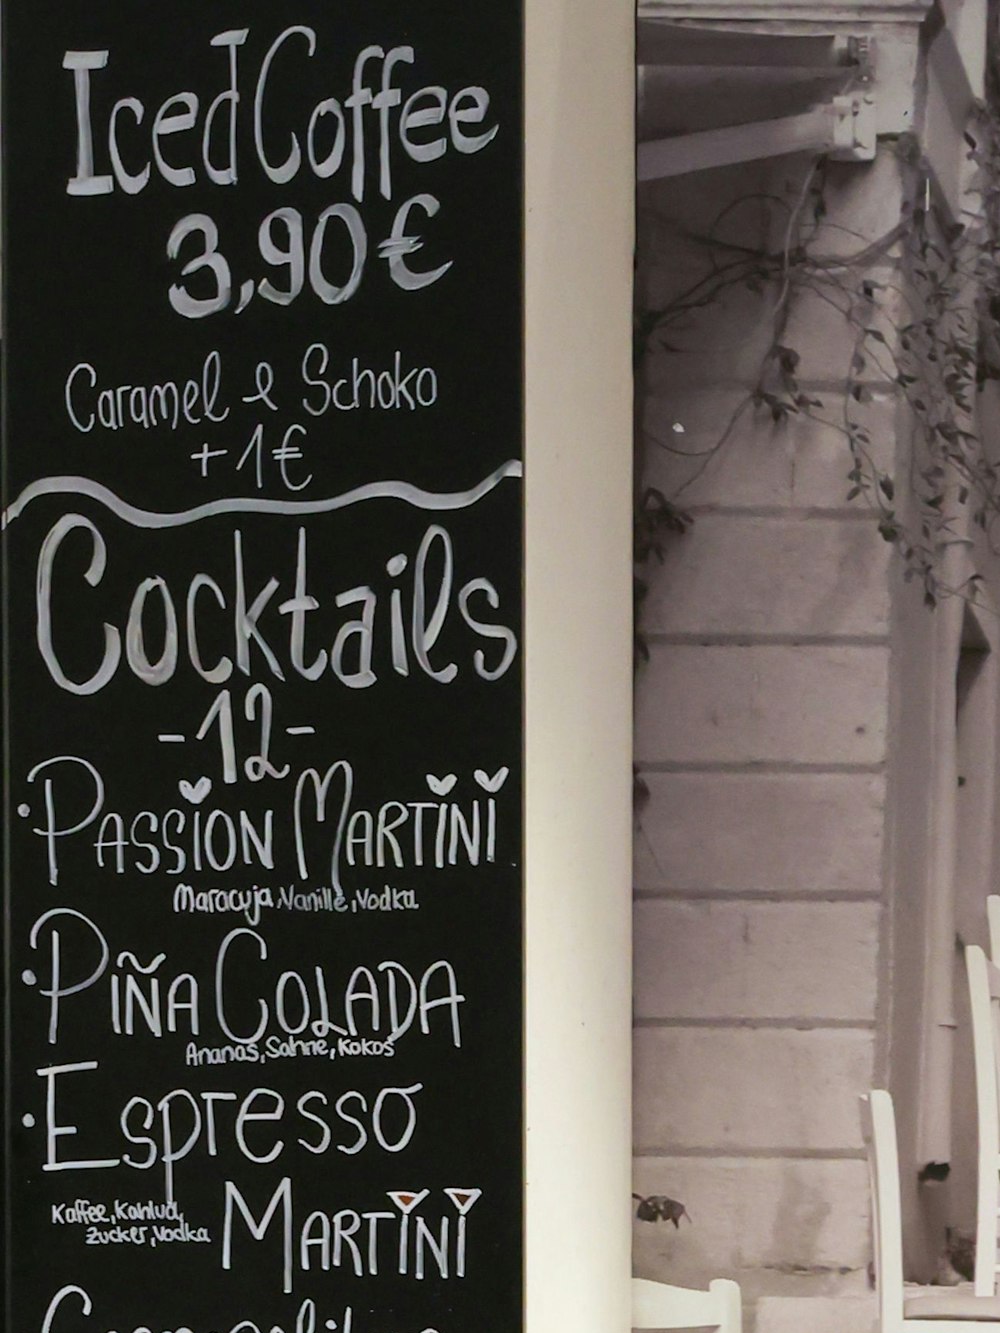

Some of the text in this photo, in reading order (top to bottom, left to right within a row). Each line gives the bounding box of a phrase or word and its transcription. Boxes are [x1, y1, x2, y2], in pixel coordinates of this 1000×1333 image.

[62, 25, 499, 202] Iced Coffee
[65, 351, 230, 432] Caramel
[303, 343, 437, 416] Schoko
[37, 513, 517, 695] Cocktails
[216, 928, 466, 1048] COLADA
[36, 1061, 423, 1201] Espresso
